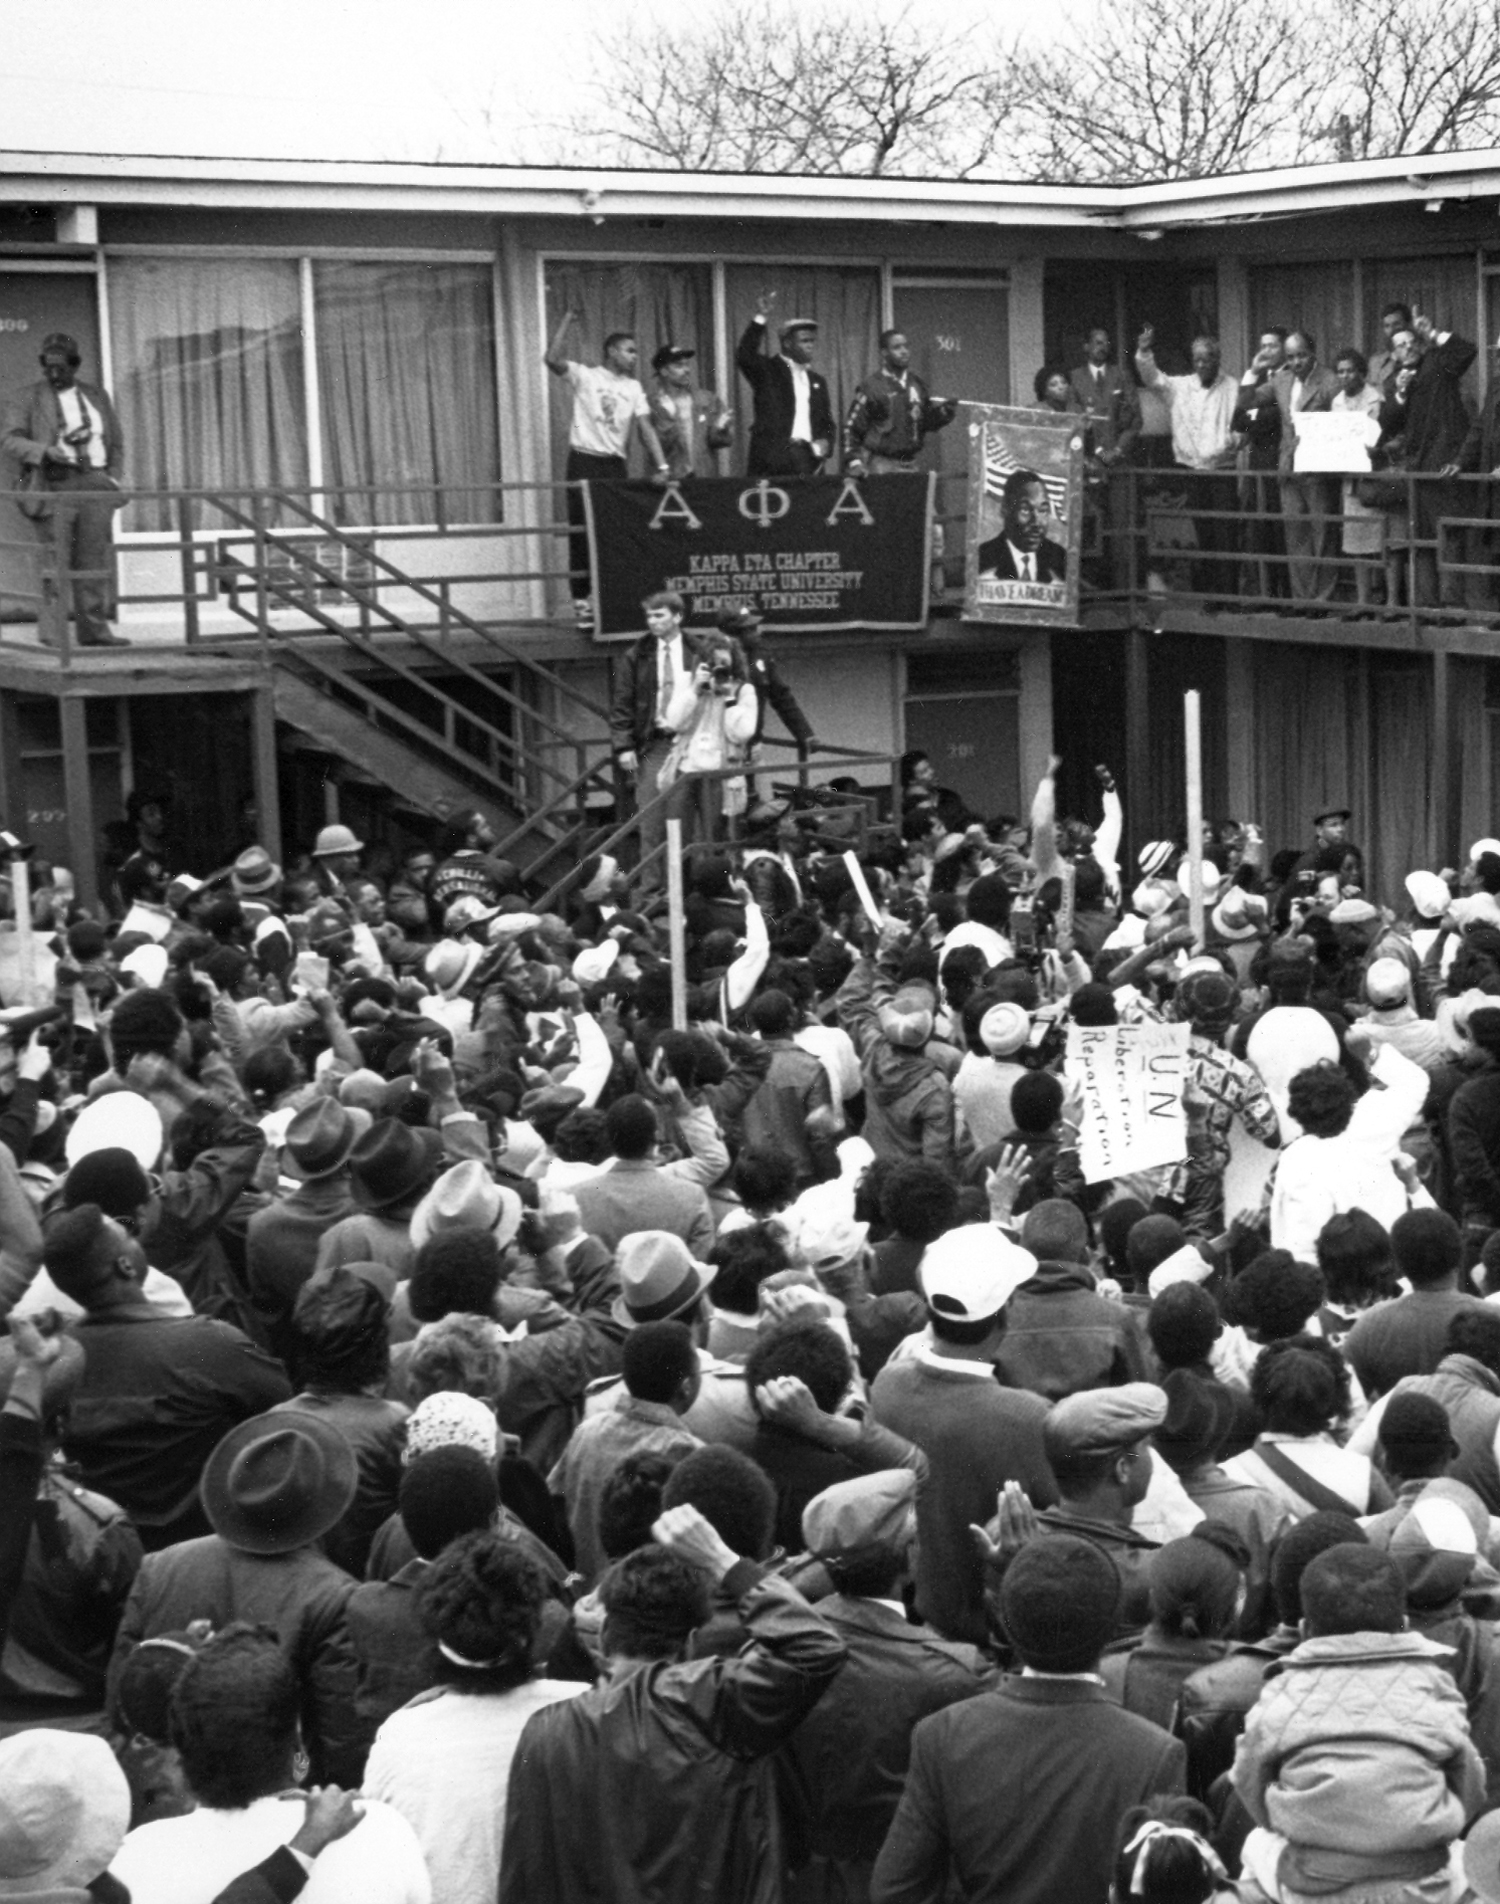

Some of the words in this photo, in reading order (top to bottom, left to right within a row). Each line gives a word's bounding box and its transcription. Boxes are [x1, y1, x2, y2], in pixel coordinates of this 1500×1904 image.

[689, 555, 740, 574] KAPPA
[744, 553, 772, 572] ETA
[776, 552, 841, 571] CHAPTER
[665, 574, 729, 594] MEMPHIS
[732, 573, 777, 591] STATE
[780, 571, 864, 590] UNIVERSITY
[761, 591, 840, 610] TENNESSEE
